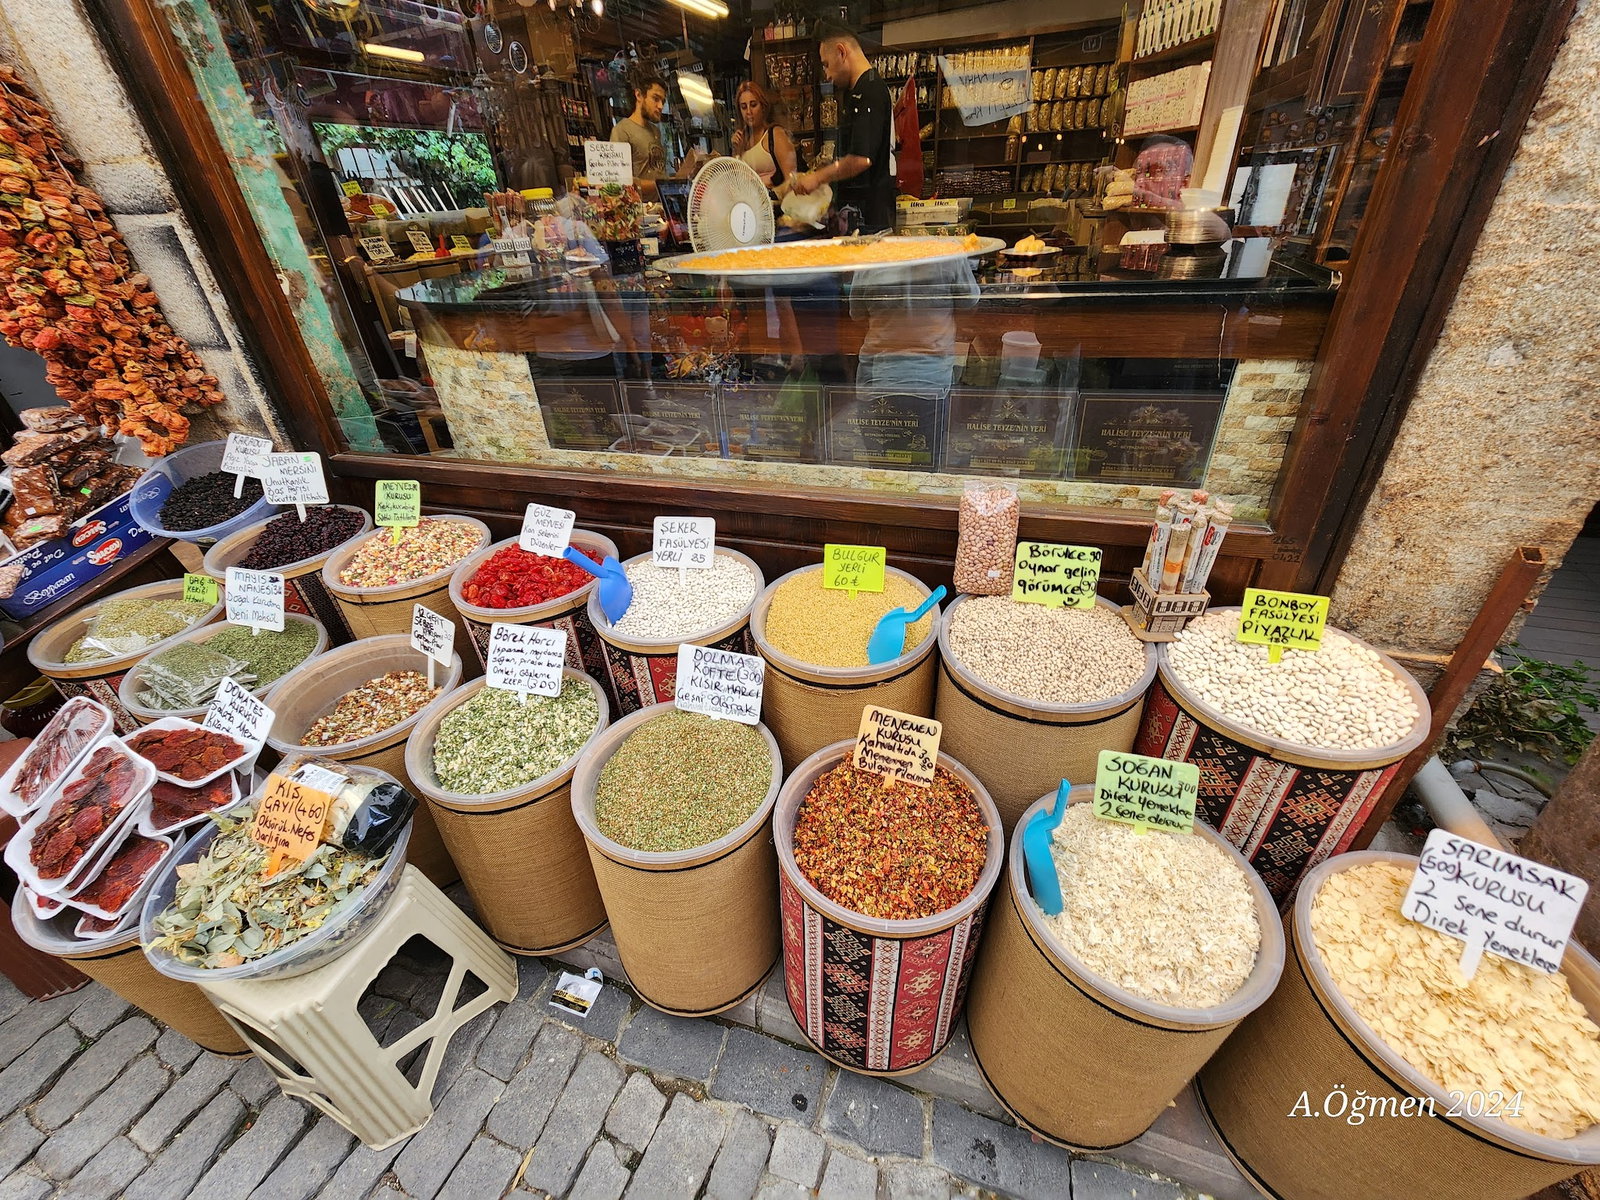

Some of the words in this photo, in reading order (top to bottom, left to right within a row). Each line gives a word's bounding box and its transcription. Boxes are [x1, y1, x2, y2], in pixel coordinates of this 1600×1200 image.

[261, 455, 300, 467] YABAN
[280, 461, 318, 476] MERSİNİ
[533, 506, 551, 518] GÜZ
[660, 521, 699, 535] ŞEKER
[659, 537, 710, 549] FASÜLYESİ
[655, 549, 683, 562] YERLİ
[832, 547, 881, 566] BULGUR
[234, 570, 267, 584] MAYIS
[837, 562, 867, 573] YERLİ
[1018, 560, 1060, 577] Oynar
[1064, 566, 1097, 580] gelin
[834, 574, 849, 587] 60
[226, 591, 250, 607] Doğal
[1254, 594, 1318, 612] BONBOY
[228, 606, 249, 621] Yeni
[1249, 608, 1320, 625] FASÜLYESİ
[494, 627, 526, 644] Börek
[527, 631, 556, 647] Harcı
[1242, 620, 1320, 642] PİYAZLIK
[693, 648, 745, 668] DOLMA
[690, 675, 722, 692] KISIR
[727, 684, 761, 699] HARCI
[224, 681, 264, 718] DOMATES
[711, 695, 756, 716] Olarak
[869, 710, 938, 736] MENEMEN
[876, 727, 922, 748] KURUSU
[1105, 756, 1173, 779] SOĞAN
[274, 779, 301, 801] KIŞ
[1100, 788, 1137, 805] Direk
[253, 827, 291, 850] Darlığına
[1441, 838, 1579, 904] SARIMSAK
[1411, 899, 1470, 937] Direk
[1414, 878, 1438, 900] 2
[1504, 916, 1565, 951] durur
